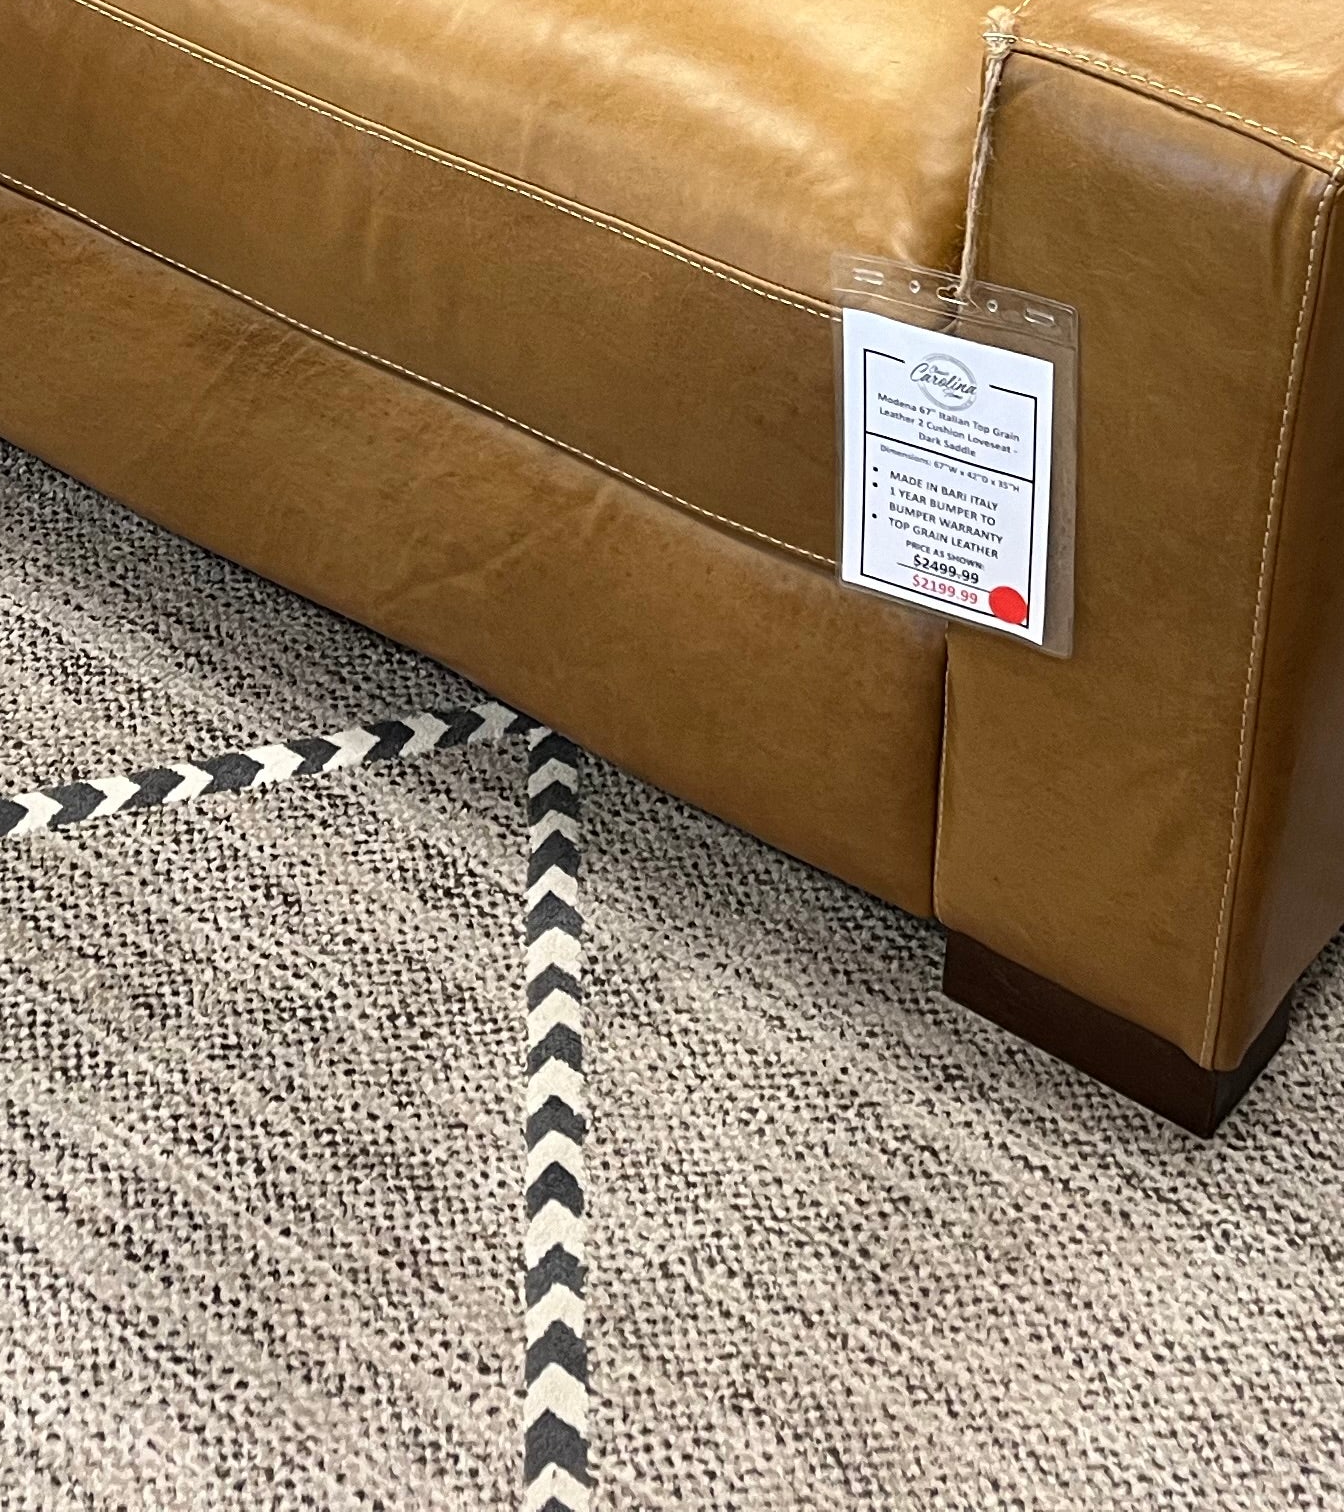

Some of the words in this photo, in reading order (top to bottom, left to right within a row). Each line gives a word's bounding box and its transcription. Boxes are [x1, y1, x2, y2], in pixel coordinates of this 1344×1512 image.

[910, 362, 977, 395] Carolina
[878, 393, 917, 411] Modena
[939, 412, 970, 427] Italian
[973, 421, 990, 434] Top
[993, 428, 1020, 442] Grain
[879, 407, 914, 424] Leather
[926, 422, 964, 438] Cushion
[967, 434, 1011, 453] Loveseat
[919, 432, 941, 446] Dark
[944, 440, 976, 457] Saddle
[890, 471, 922, 487] MADE
[926, 482, 938, 493] IN
[941, 486, 967, 501] BARI
[970, 495, 998, 511] ITALY
[890, 487, 895, 495] 1
[899, 490, 926, 505] YEAR
[930, 499, 977, 521] BUMPER
[980, 514, 996, 526] TO
[889, 517, 910, 530] TOP
[913, 525, 947, 543] GRAIN
[951, 537, 999, 559] LEATHER
[890, 502, 936, 524] BUMPER
[939, 516, 1003, 544] WARRANTY
[906, 540, 930, 554] PRICE
[933, 549, 944, 558] AS
[914, 554, 979, 584] $2499.99
[912, 574, 978, 604] $2199.99
